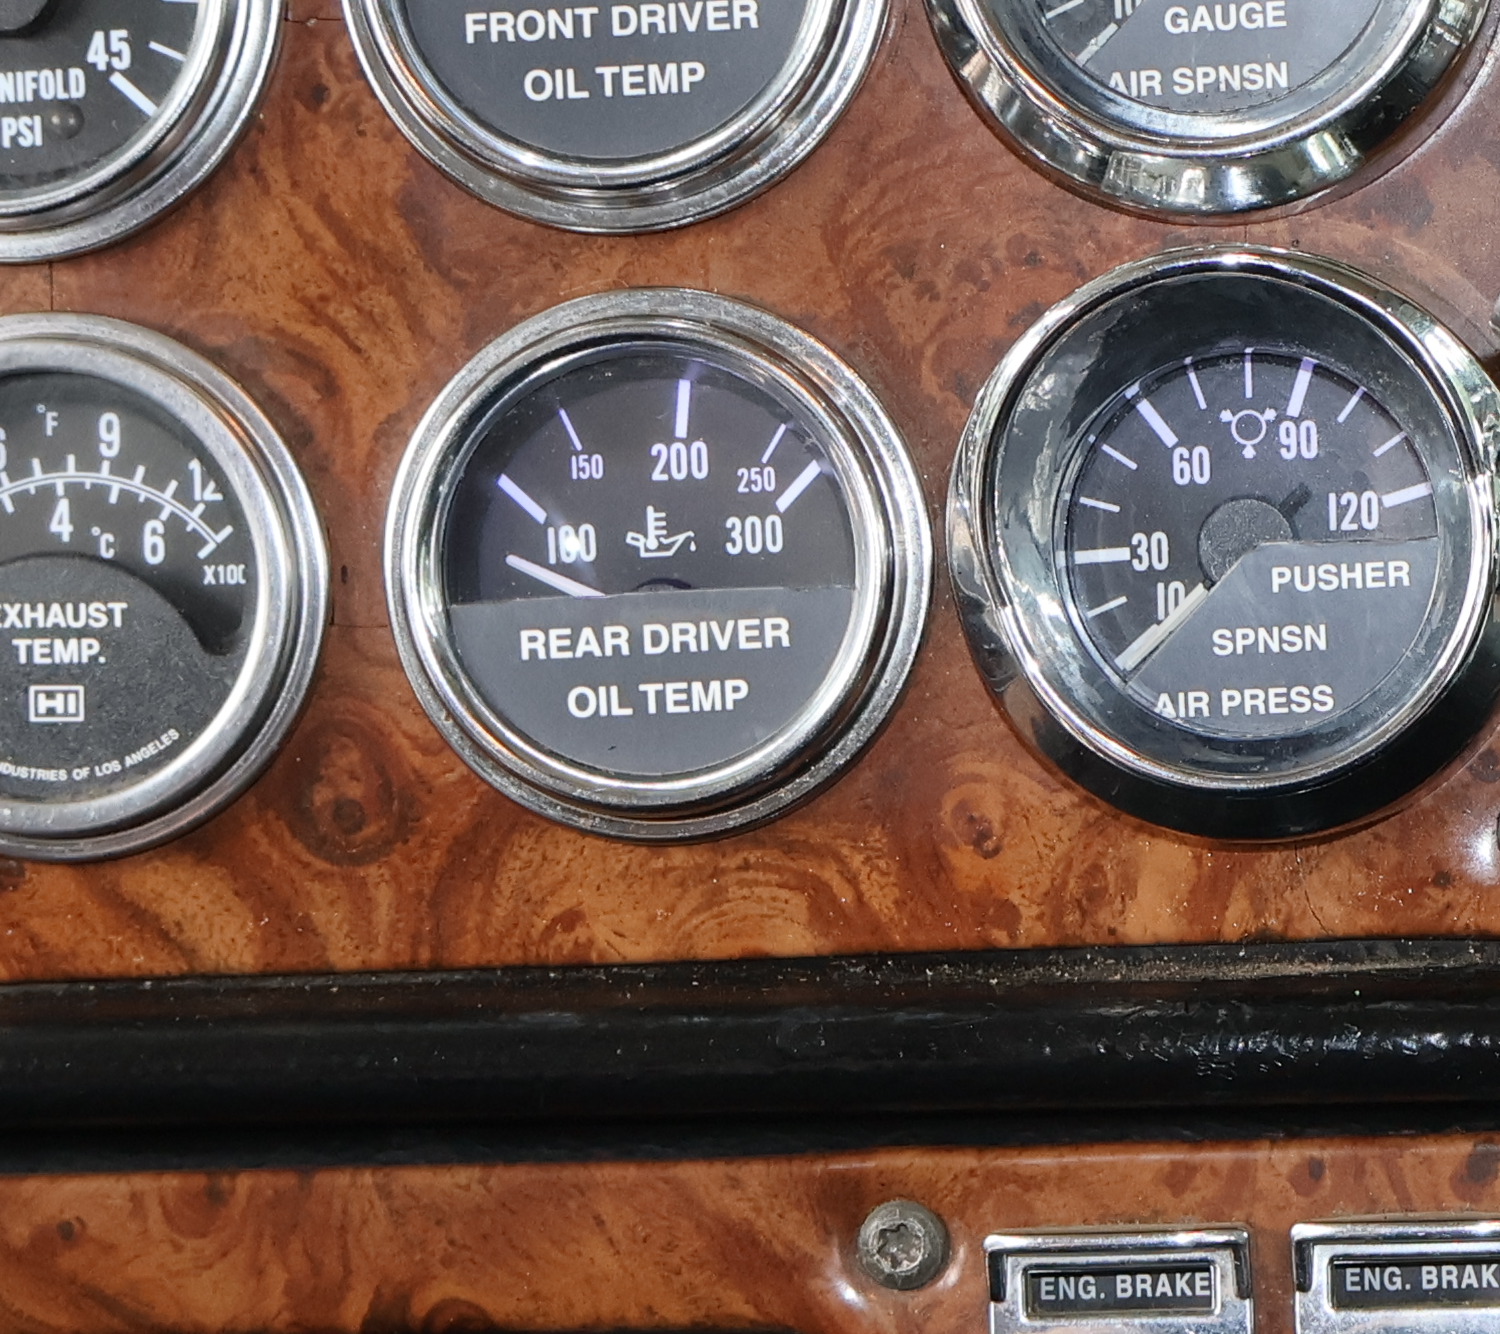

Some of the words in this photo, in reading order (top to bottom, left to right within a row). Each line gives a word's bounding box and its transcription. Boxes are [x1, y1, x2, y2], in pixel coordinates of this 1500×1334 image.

[464, 7, 599, 44] FRONT
[1163, 1, 1288, 35] GAUGE
[87, 30, 131, 71] 45
[524, 68, 590, 102] OIL
[595, 61, 706, 98] TEMP
[1109, 69, 1162, 99] AIR
[1172, 62, 1289, 96] SPNSN
[2, 116, 43, 148] PSI
[99, 413, 121, 457] 9
[1279, 420, 1318, 460] 90
[571, 454, 603, 480] 150
[651, 441, 708, 481] 200
[737, 467, 776, 493] 250
[1172, 446, 1211, 485] 60
[50, 499, 72, 541] 4
[1327, 492, 1379, 532] 120
[143, 520, 165, 564] 6
[547, 524, 597, 564] 100
[725, 515, 783, 555] 300
[1131, 532, 1169, 571] 30
[1271, 561, 1411, 594] PUSHER
[1156, 581, 1186, 620] 10
[12, 638, 106, 665] TEMP.
[520, 625, 630, 661] REAR
[643, 617, 790, 655] DRIVER
[1212, 624, 1327, 656] SPNSN
[35, 695, 78, 716] HI
[567, 685, 632, 718] OIL
[638, 679, 749, 715] TEMP
[1154, 690, 1210, 720] AIR
[1221, 685, 1335, 717] PRESS
[72, 767, 91, 781] OF
[95, 759, 122, 777] LOS
[124, 728, 180, 767] ANGELES
[1040, 1274, 1106, 1302] ENG.
[1116, 1271, 1211, 1299] BRAKE
[1345, 1266, 1412, 1292] ENG.
